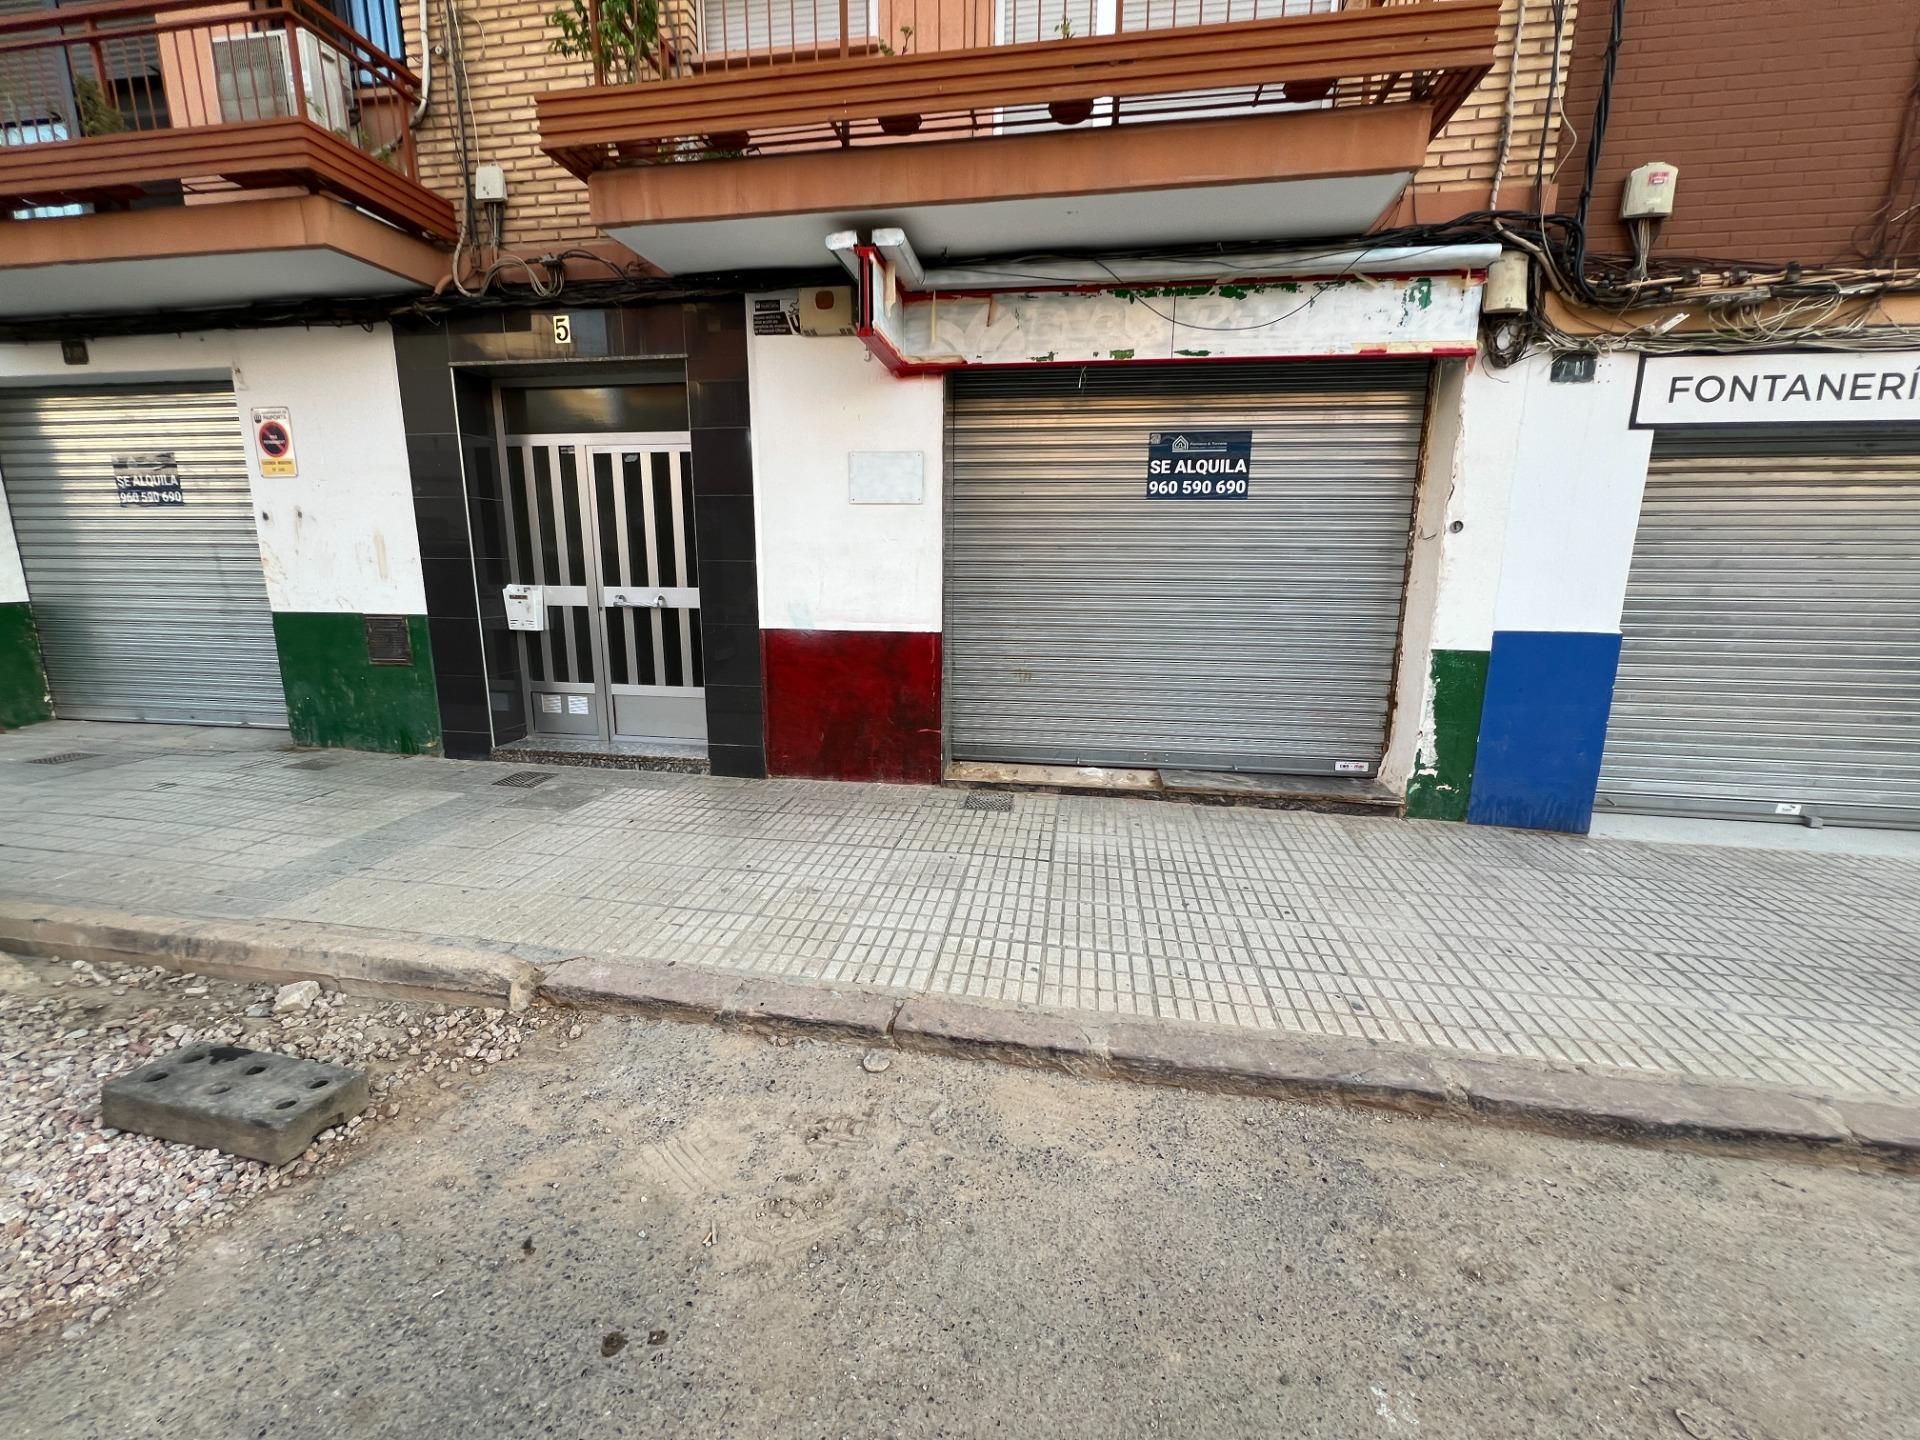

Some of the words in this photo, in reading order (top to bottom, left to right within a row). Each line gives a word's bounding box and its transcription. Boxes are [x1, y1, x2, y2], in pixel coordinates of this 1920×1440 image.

[556, 318, 568, 341] 5
[1667, 364, 1920, 404] FONTANERÍ
[1150, 459, 1172, 474] SE
[1174, 458, 1247, 475] ALQUILA
[116, 475, 131, 488] SE
[133, 474, 178, 487] ALQUILA
[1149, 480, 1178, 494] 960
[1182, 480, 1212, 494] 590
[1215, 480, 1246, 494] 690
[161, 491, 182, 502] 690
